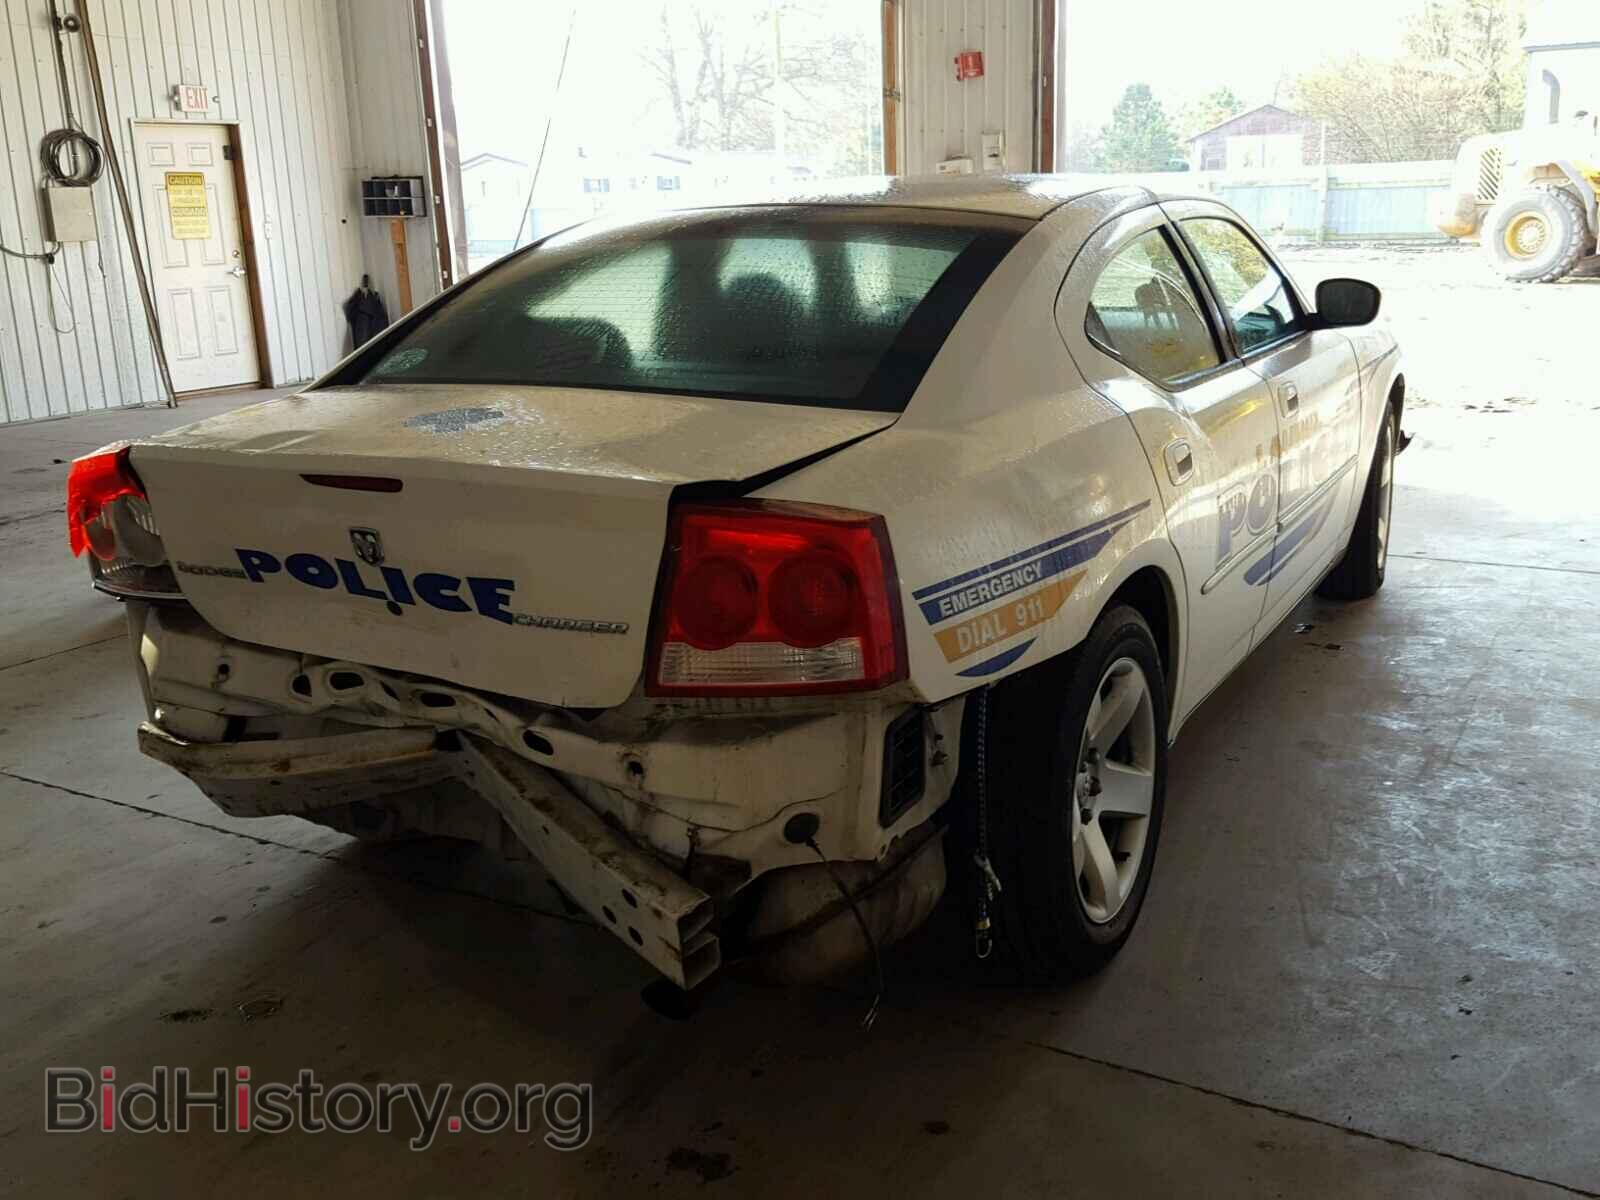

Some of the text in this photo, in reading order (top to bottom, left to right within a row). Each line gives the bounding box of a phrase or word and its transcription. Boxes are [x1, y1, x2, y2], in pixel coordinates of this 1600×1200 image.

[186, 87, 208, 109] EXIT
[169, 175, 203, 185] CAUTION
[235, 548, 516, 625] POLICE
[938, 562, 1043, 617] EMERGENCY
[513, 613, 629, 635] CHARGER
[956, 597, 1044, 653] DIAL 911
